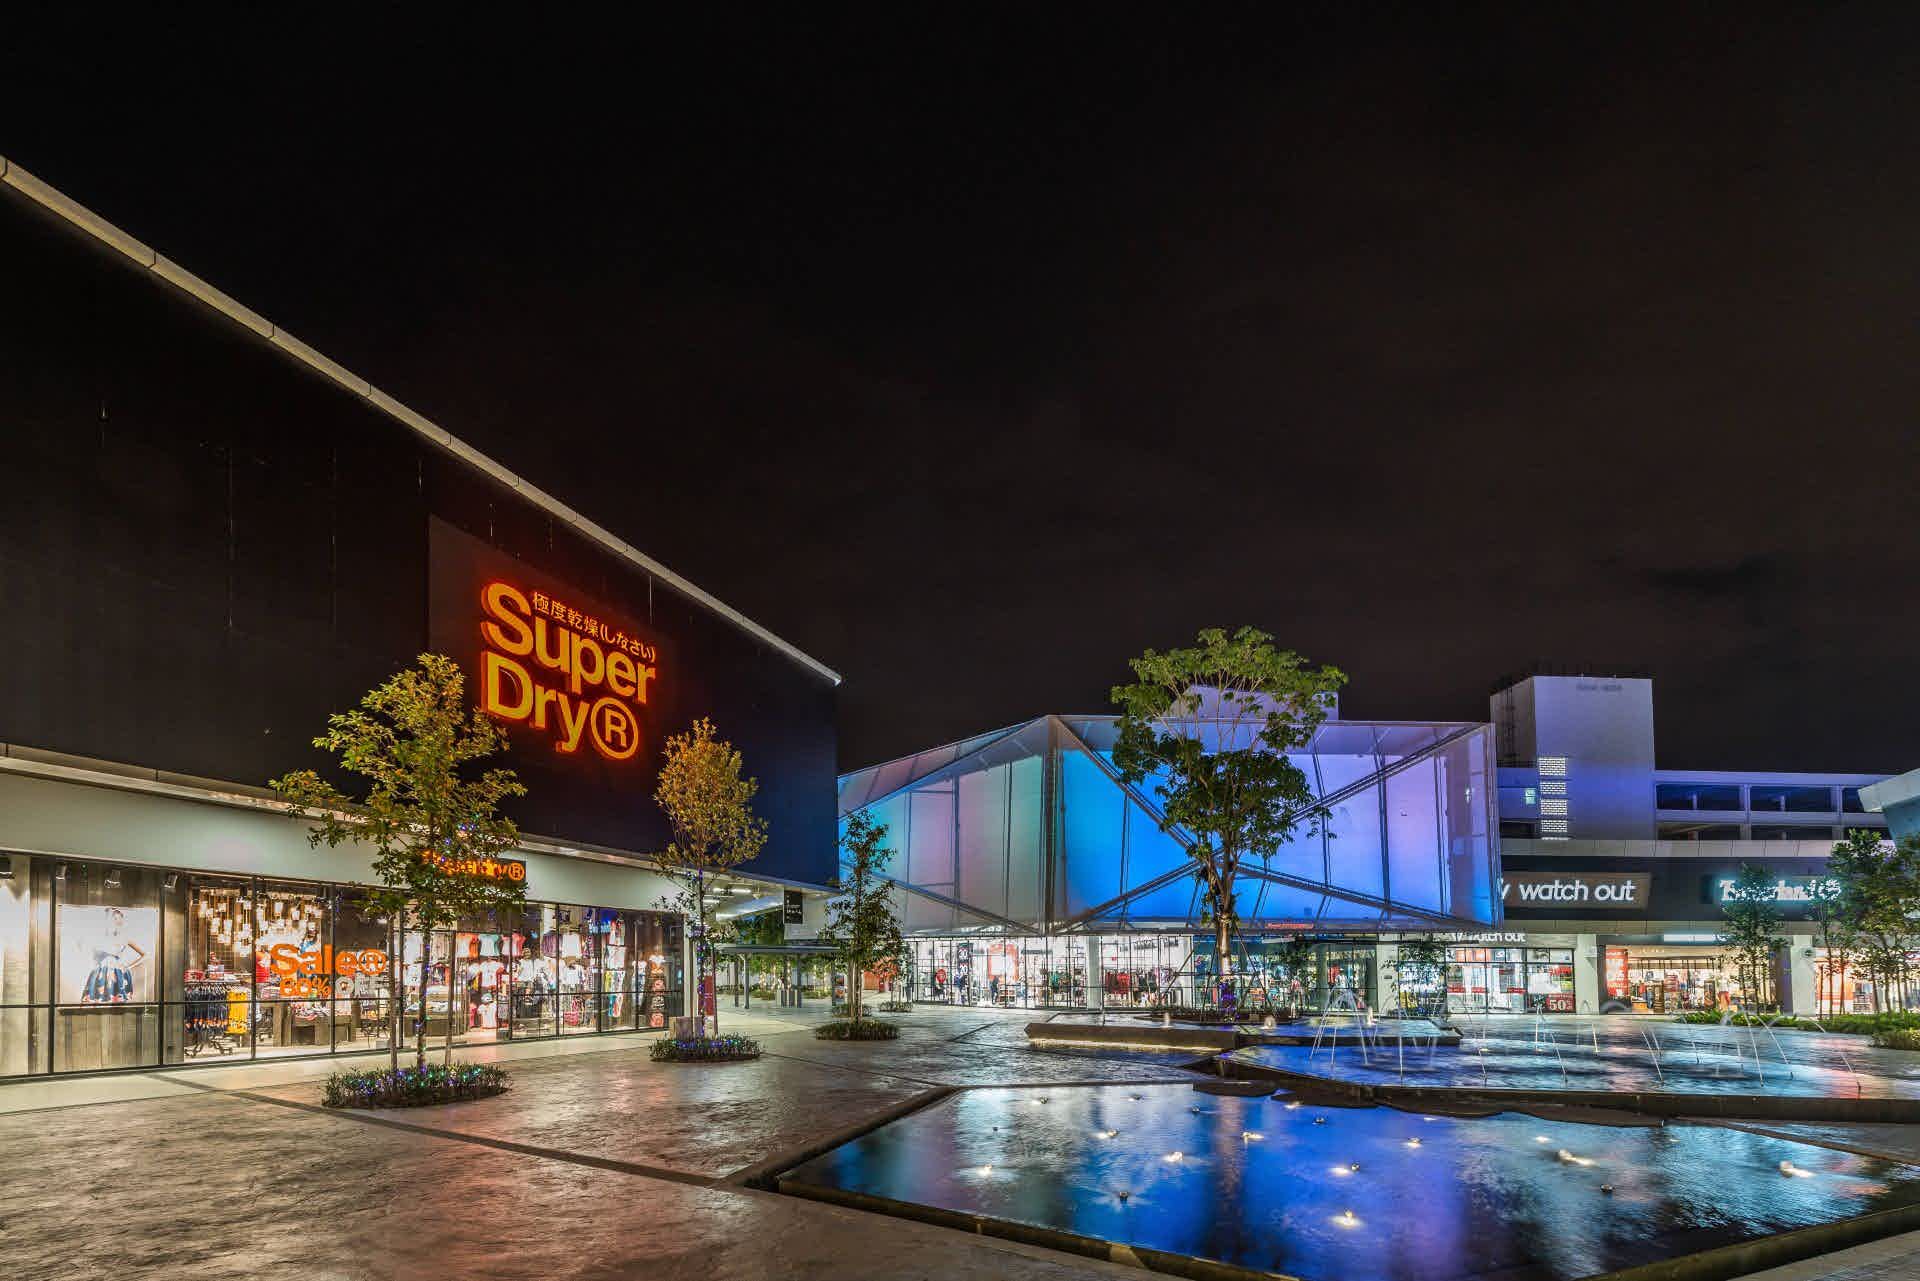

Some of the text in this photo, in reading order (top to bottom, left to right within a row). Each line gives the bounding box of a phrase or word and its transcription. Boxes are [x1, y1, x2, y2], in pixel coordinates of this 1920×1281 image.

[483, 582, 655, 704] Super
[1519, 879, 1588, 900] watch
[1594, 879, 1636, 901] out
